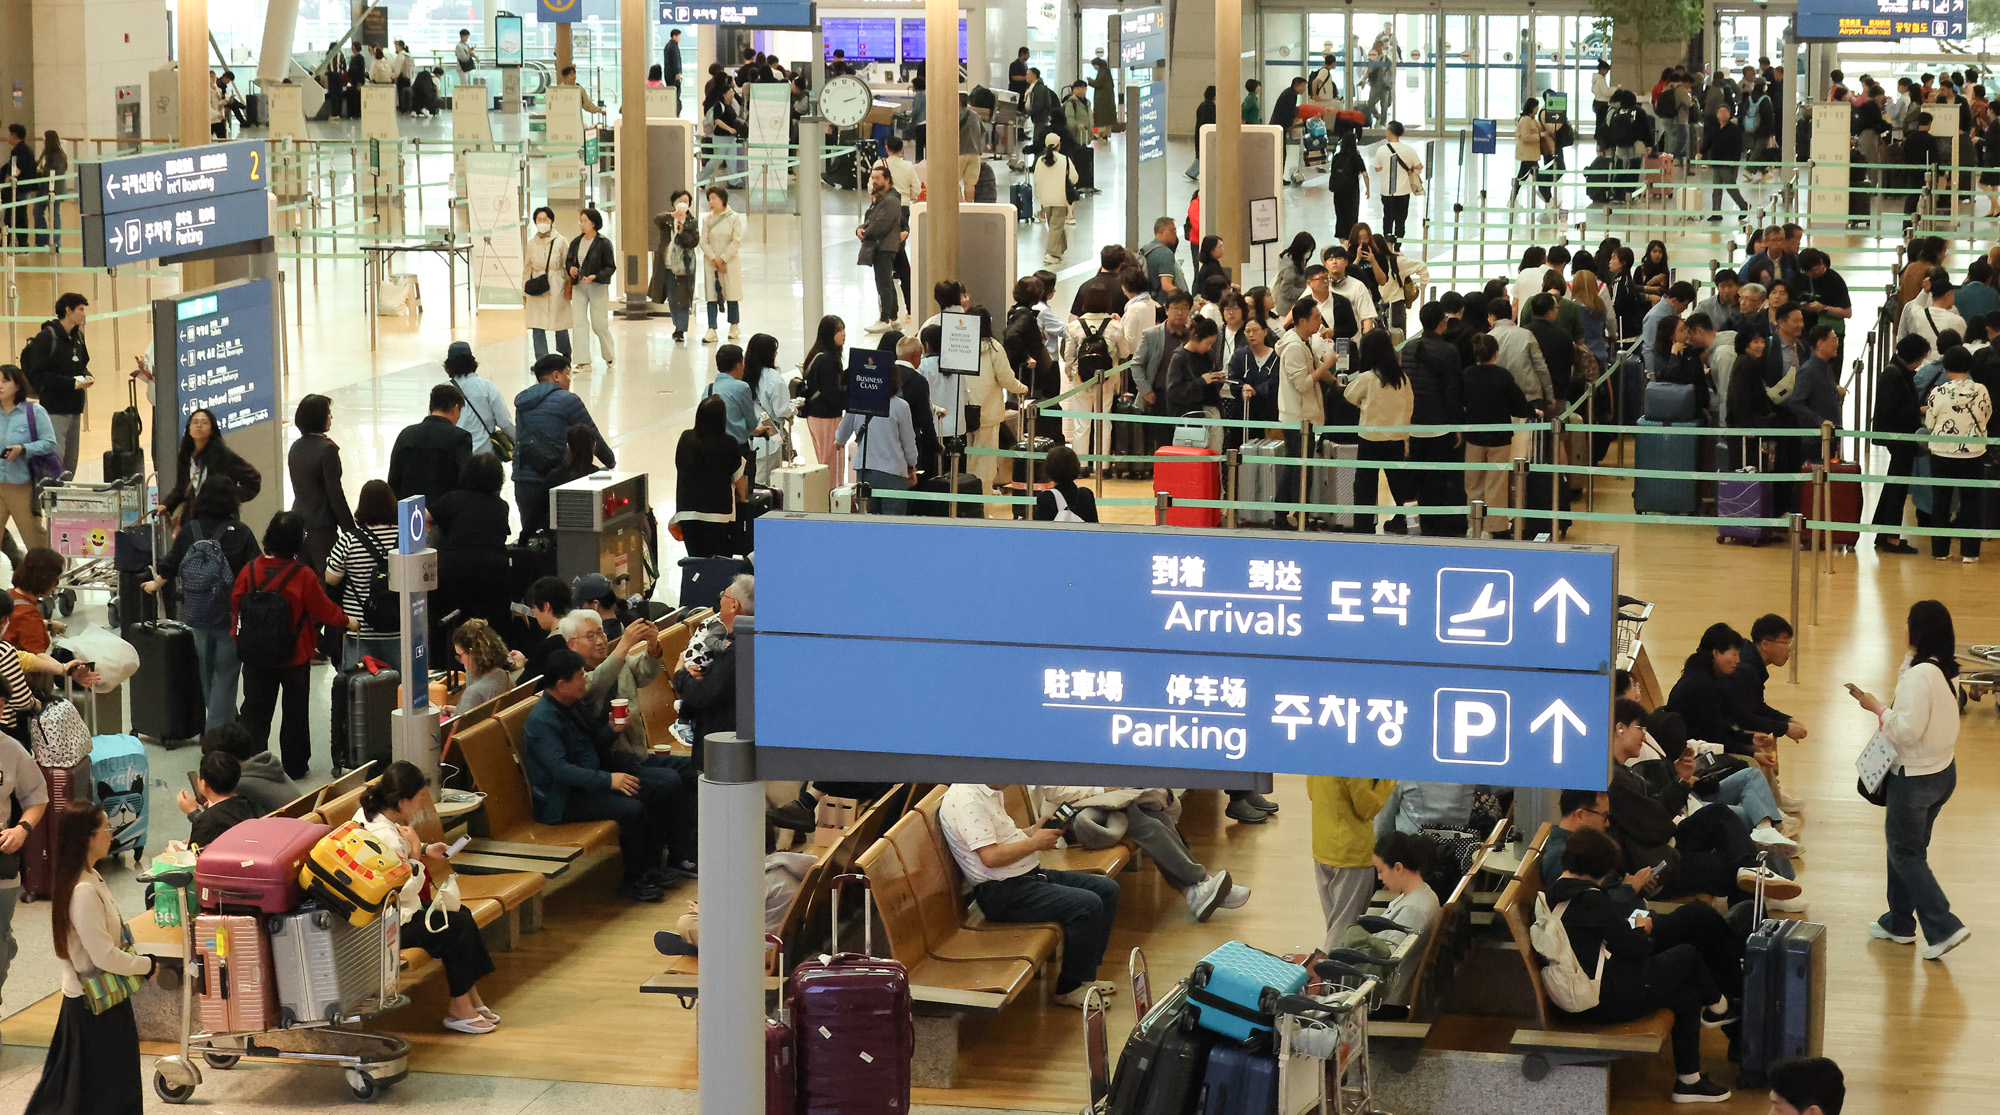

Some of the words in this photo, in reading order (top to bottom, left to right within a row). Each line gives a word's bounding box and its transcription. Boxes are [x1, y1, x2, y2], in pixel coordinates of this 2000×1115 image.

[1839, 28, 1863, 36] Airport
[1864, 27, 1891, 36] Railroad
[249, 150, 260, 181] 2
[166, 178, 181, 195] Int'l
[182, 175, 215, 193] Boarding
[144, 219, 173, 246] 주차장
[175, 228, 204, 246] Parking
[856, 374, 883, 384] BUSINESS
[860, 381, 879, 390] CLASS
[199, 399, 208, 410] Tax
[209, 392, 228, 408] Refund
[1152, 555, 1205, 587] 到着
[1249, 560, 1302, 592] 到达
[1328, 578, 1411, 626] 도착
[1165, 601, 1302, 637] Arrivals
[1044, 668, 1123, 703] 駐車場
[1166, 673, 1247, 708] 停车场
[1271, 694, 1408, 748] 주차장
[1454, 701, 1497, 754] P
[1112, 714, 1247, 760] Parking
